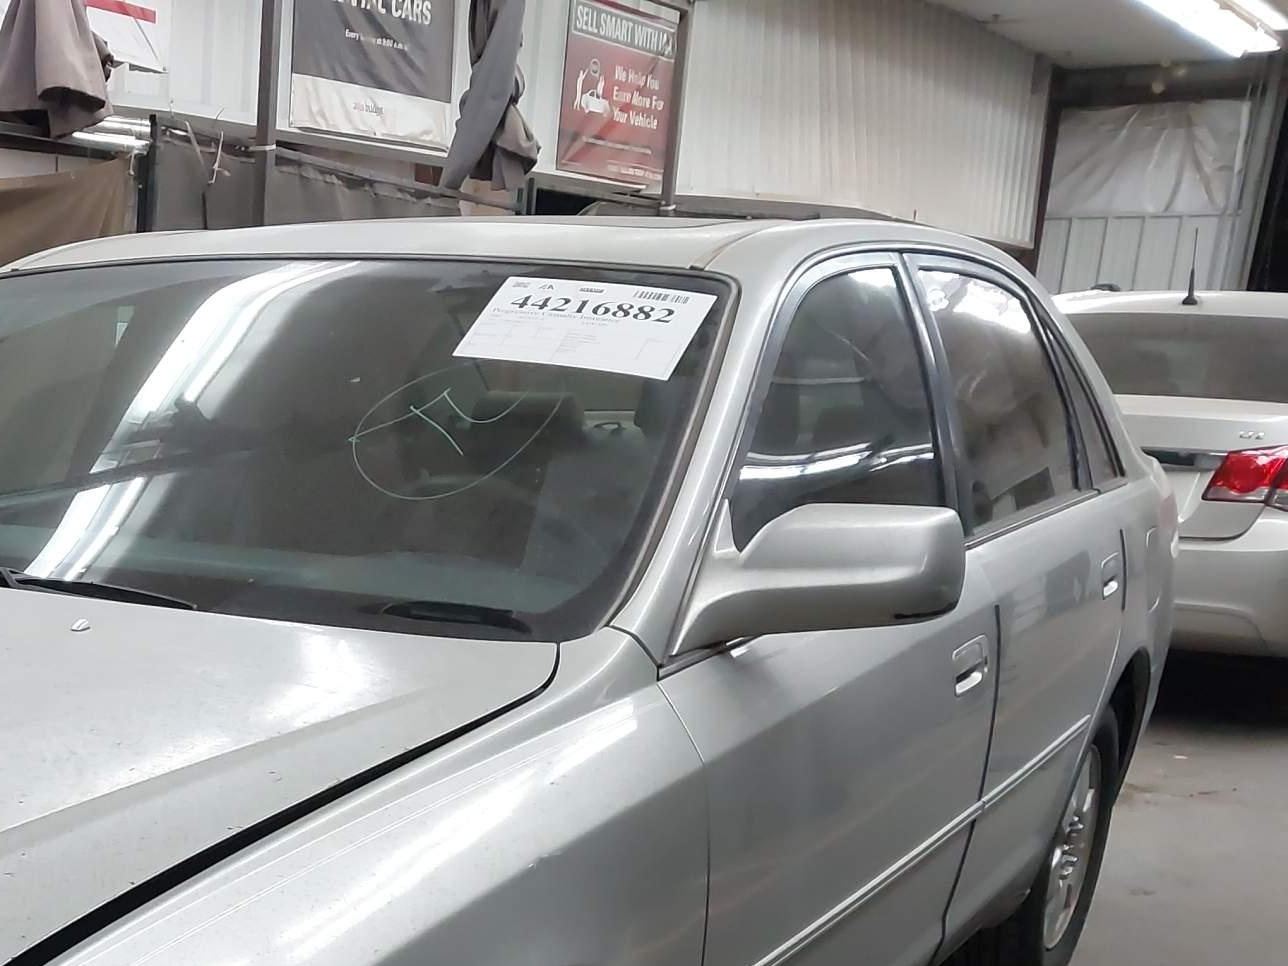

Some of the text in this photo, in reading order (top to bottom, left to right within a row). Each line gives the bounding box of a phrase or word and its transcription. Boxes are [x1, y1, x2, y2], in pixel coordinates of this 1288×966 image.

[391, 0, 432, 25] CARS
[576, 5, 598, 33] SELL
[600, 13, 634, 43] SMART
[635, 24, 658, 51] WITH
[615, 64, 660, 90] We Help You
[631, 90, 650, 108] More
[613, 106, 658, 129] Your Vehicle
[510, 294, 675, 323] 44216882
